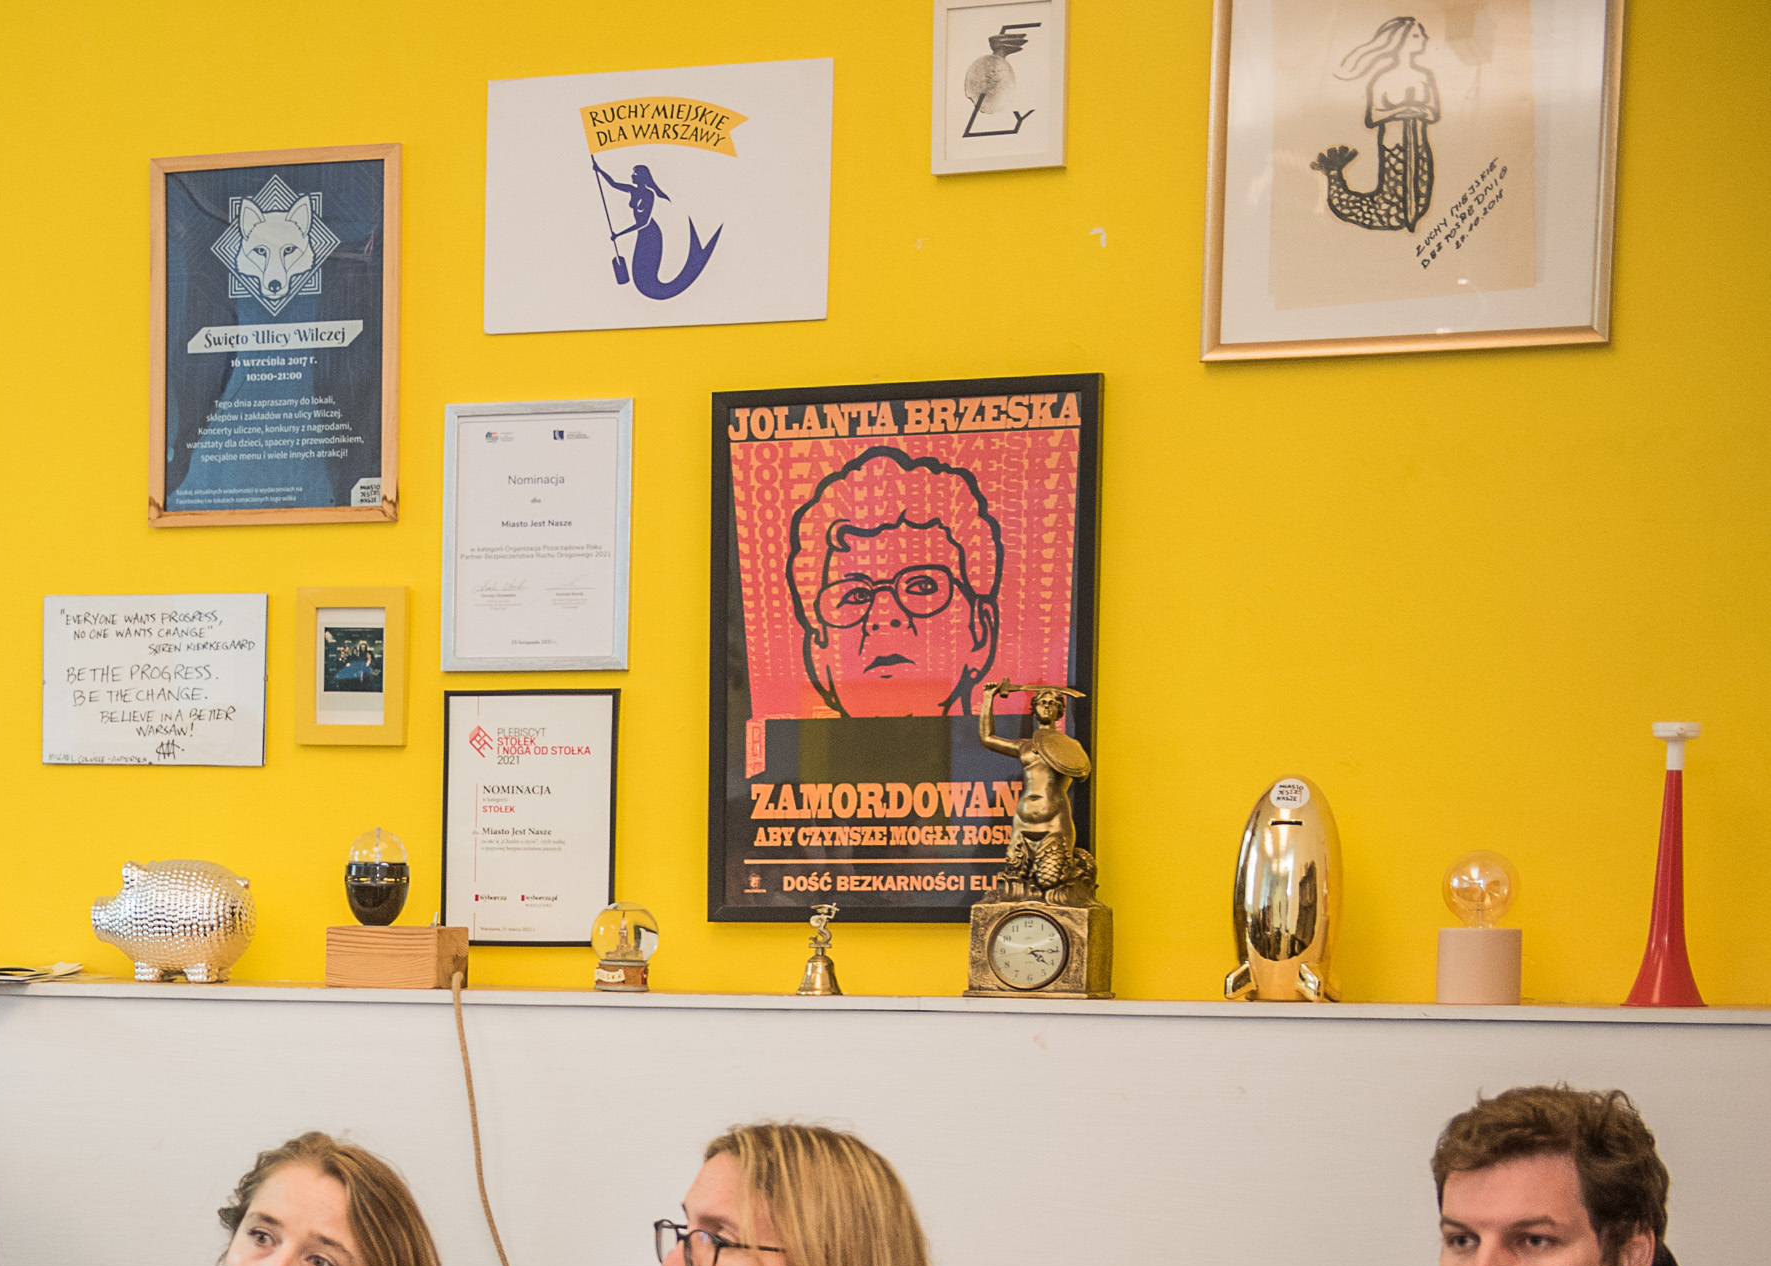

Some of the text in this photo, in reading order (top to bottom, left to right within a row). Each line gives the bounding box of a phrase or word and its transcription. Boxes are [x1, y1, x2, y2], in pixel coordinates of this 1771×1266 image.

[589, 103, 729, 131] RUCHY MIEJSKIE
[596, 123, 726, 146] DLA WARSZAWY
[204, 327, 346, 349] Święto Ulicy Wilczej
[231, 356, 318, 368] 16 września 2017 r.
[246, 372, 303, 381] 10:00-21:00
[214, 395, 336, 410] Tego dnia zapraszamy do lokali,
[206, 413, 238, 423] sklepów
[240, 412, 243, 420] i
[244, 411, 283, 420] zakładów
[294, 411, 312, 420] ulicy
[313, 409, 343, 419] Wilczej.
[728, 392, 1081, 441] JOLANTA BRZESKA
[198, 427, 232, 436] Koncerty
[233, 426, 264, 435] uliczne,
[265, 424, 300, 434] konkursy
[307, 421, 352, 433] nagrodami,
[186, 440, 224, 450] warsztaty
[224, 439, 237, 447] dla
[238, 439, 263, 448] dzieci,
[265, 438, 295, 448] spacery
[301, 434, 364, 446] przewodnikiem,
[201, 452, 238, 463] specjalne
[267, 450, 288, 459] wiele
[289, 450, 315, 460] innych
[317, 448, 348, 459] atrakcji!
[508, 474, 565, 487] Nominacja
[502, 520, 528, 528] Miasto
[548, 519, 572, 527] Nasze
[124, 613, 156, 624] WANTS
[161, 610, 223, 626] PROGRESS,
[74, 629, 86, 640] NO
[89, 628, 109, 639] ONE
[116, 627, 153, 638] WANTS
[186, 639, 256, 652] KIERKEGAARD
[66, 664, 220, 684] BE THE PROGRESS.
[72, 687, 208, 707] BE THE CHANGE.
[99, 705, 237, 724] BELIEVE IN A BETTER
[135, 722, 194, 737] WARSAW!
[497, 728, 546, 737] PLEBISCYT
[497, 737, 536, 746] STOŁEK
[497, 746, 591, 755] I NOGA OD STOŁKA
[497, 755, 520, 765] 2021
[483, 785, 551, 796] NOMINACJA
[750, 781, 1023, 819] ZAMORDOWAN
[482, 805, 515, 813] STOŁEK
[482, 827, 509, 835] Miasto
[512, 828, 526, 836] Jest
[754, 827, 795, 846] ABY
[797, 826, 888, 846] CZYNSZE
[890, 825, 960, 846] MOGŁY
[783, 871, 997, 892] DOŚĆ BEZKARNOŚCI ELI
